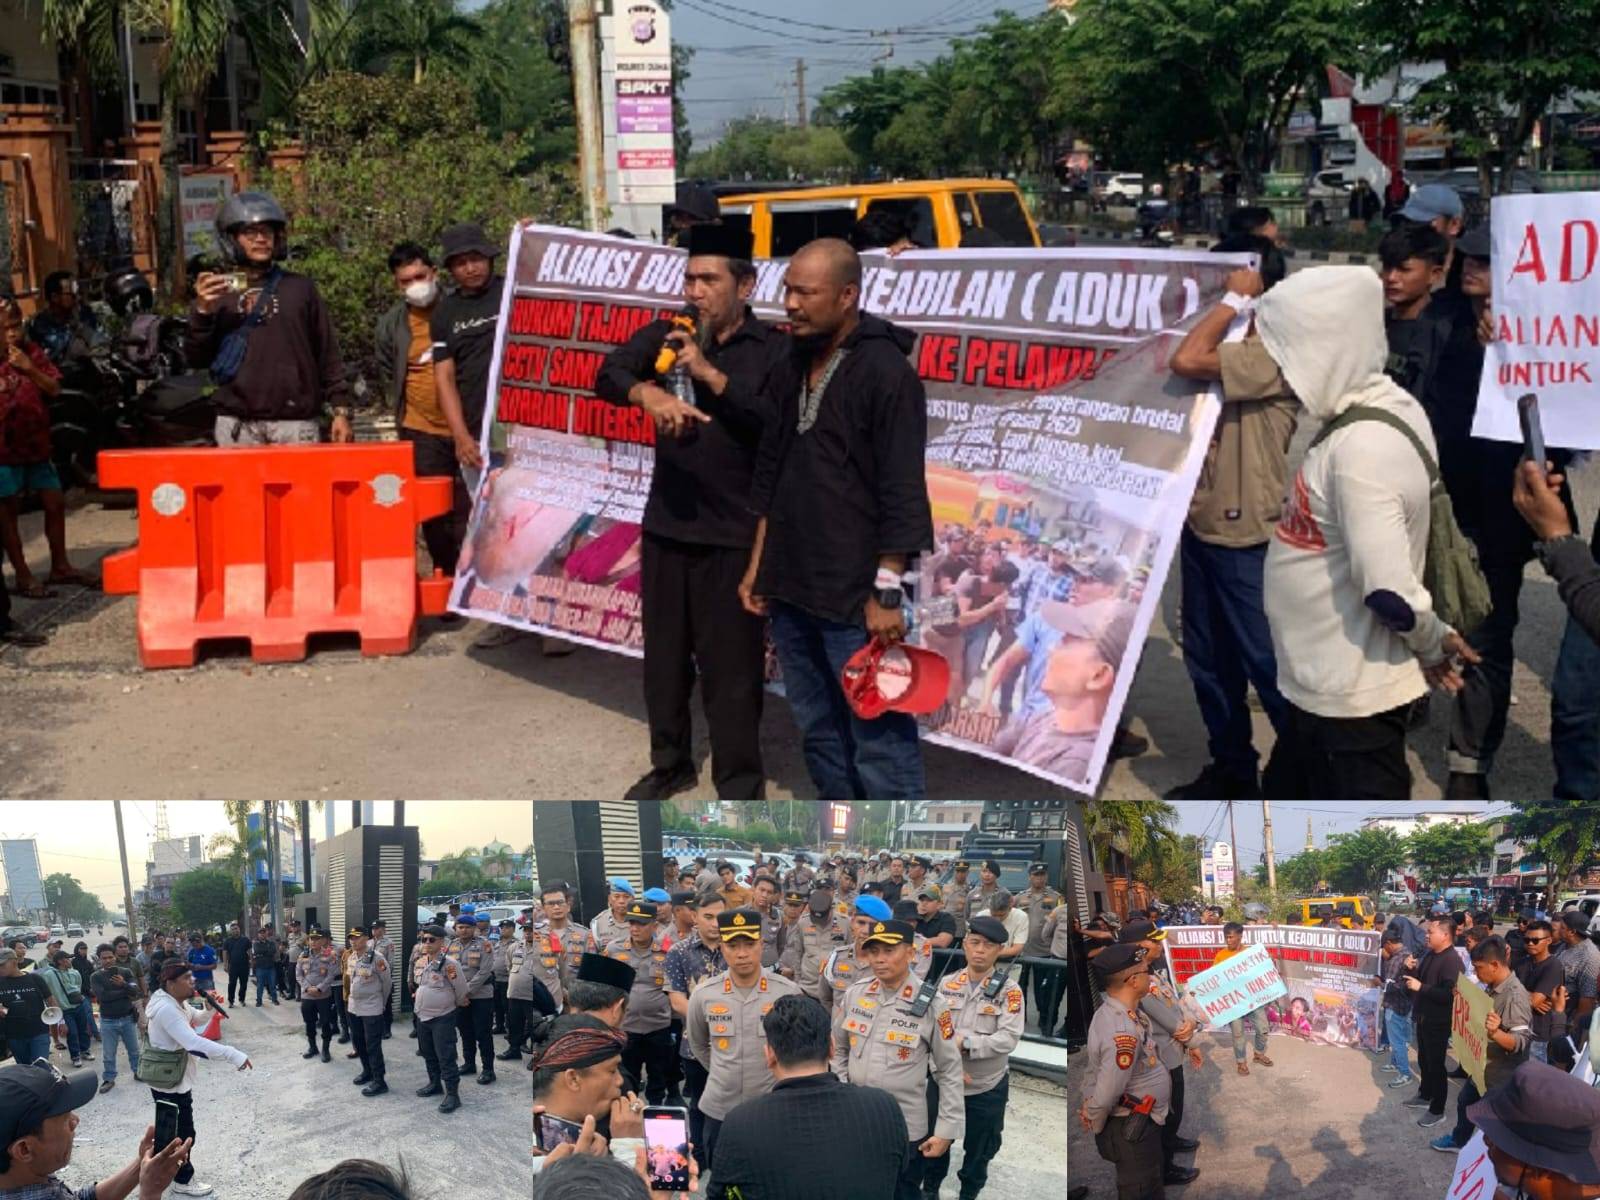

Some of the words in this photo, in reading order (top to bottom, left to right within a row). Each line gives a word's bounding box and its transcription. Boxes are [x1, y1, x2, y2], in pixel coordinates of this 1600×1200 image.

[619, 81, 669, 94] SPKT
[1506, 219, 1599, 286] AD
[536, 242, 643, 288] ALIANSI
[1046, 271, 1168, 329] ADUK
[502, 342, 549, 384] CCTV
[919, 334, 960, 381] KE
[1496, 360, 1593, 388] UNTUK
[496, 384, 570, 433] KORBAN
[1177, 930, 1216, 945] ALIANSI
[1254, 930, 1286, 944] UNTUK
[1288, 930, 1336, 949] KEADILAN
[1205, 989, 1247, 1018] MAFIA
[891, 1018, 919, 1030] POLRI
